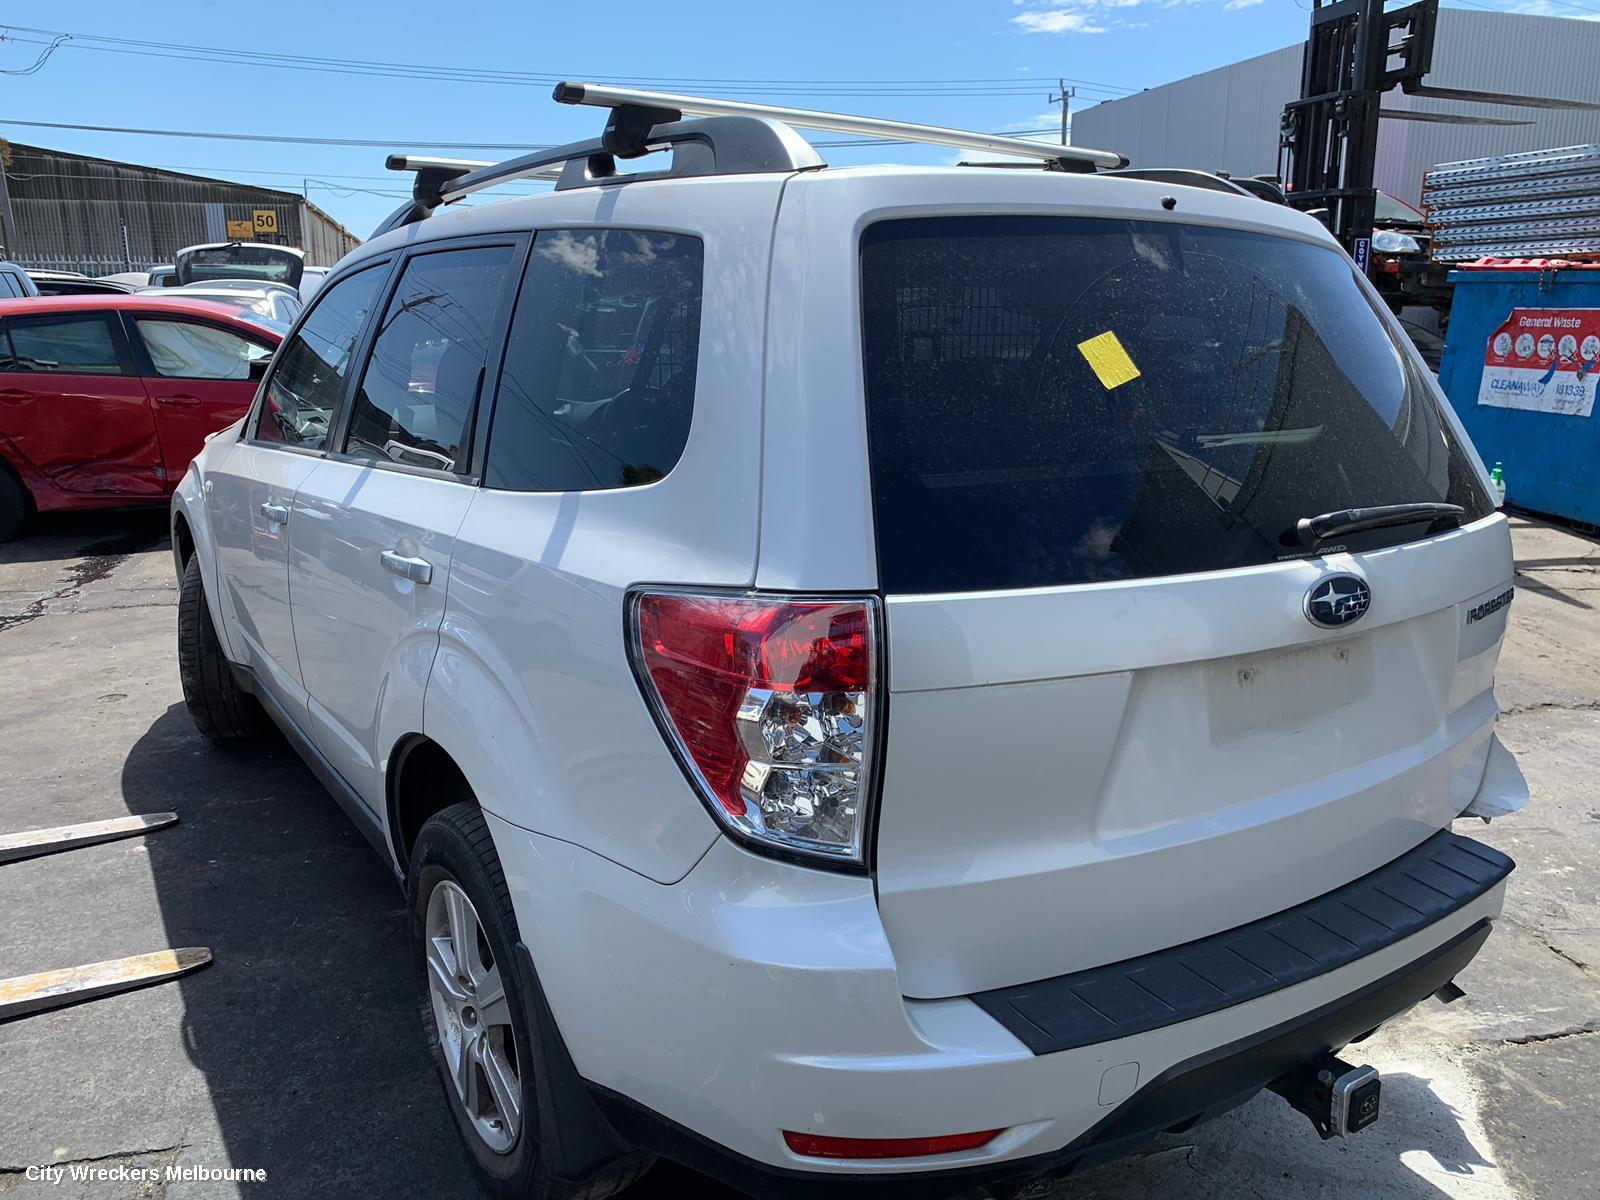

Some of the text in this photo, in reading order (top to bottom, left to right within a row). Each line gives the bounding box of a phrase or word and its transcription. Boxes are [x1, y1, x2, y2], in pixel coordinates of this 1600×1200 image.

[256, 215, 274, 227] 50
[1519, 316, 1581, 328] General Waste
[1316, 544, 1348, 555] AWD
